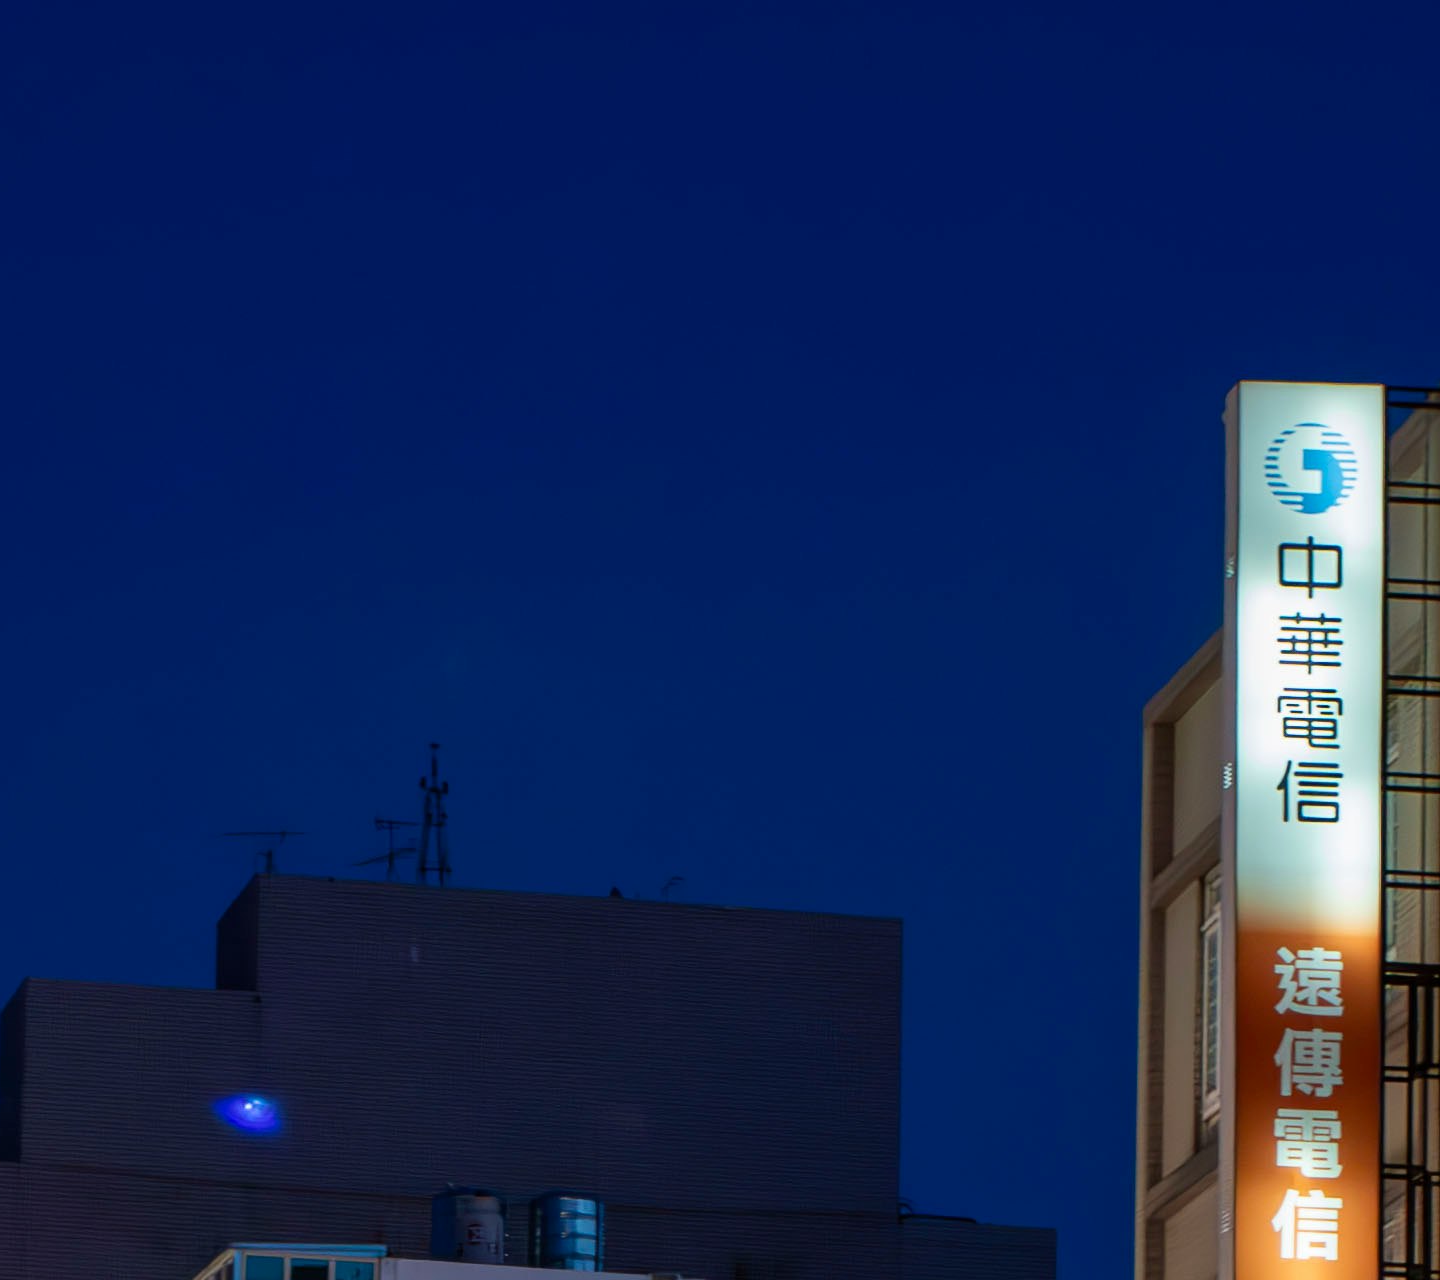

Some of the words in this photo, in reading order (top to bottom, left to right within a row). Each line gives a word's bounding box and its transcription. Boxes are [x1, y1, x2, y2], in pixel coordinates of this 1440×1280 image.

[1277, 536, 1344, 823] 中華電信
[1272, 947, 1344, 1261] 遠傳電信
